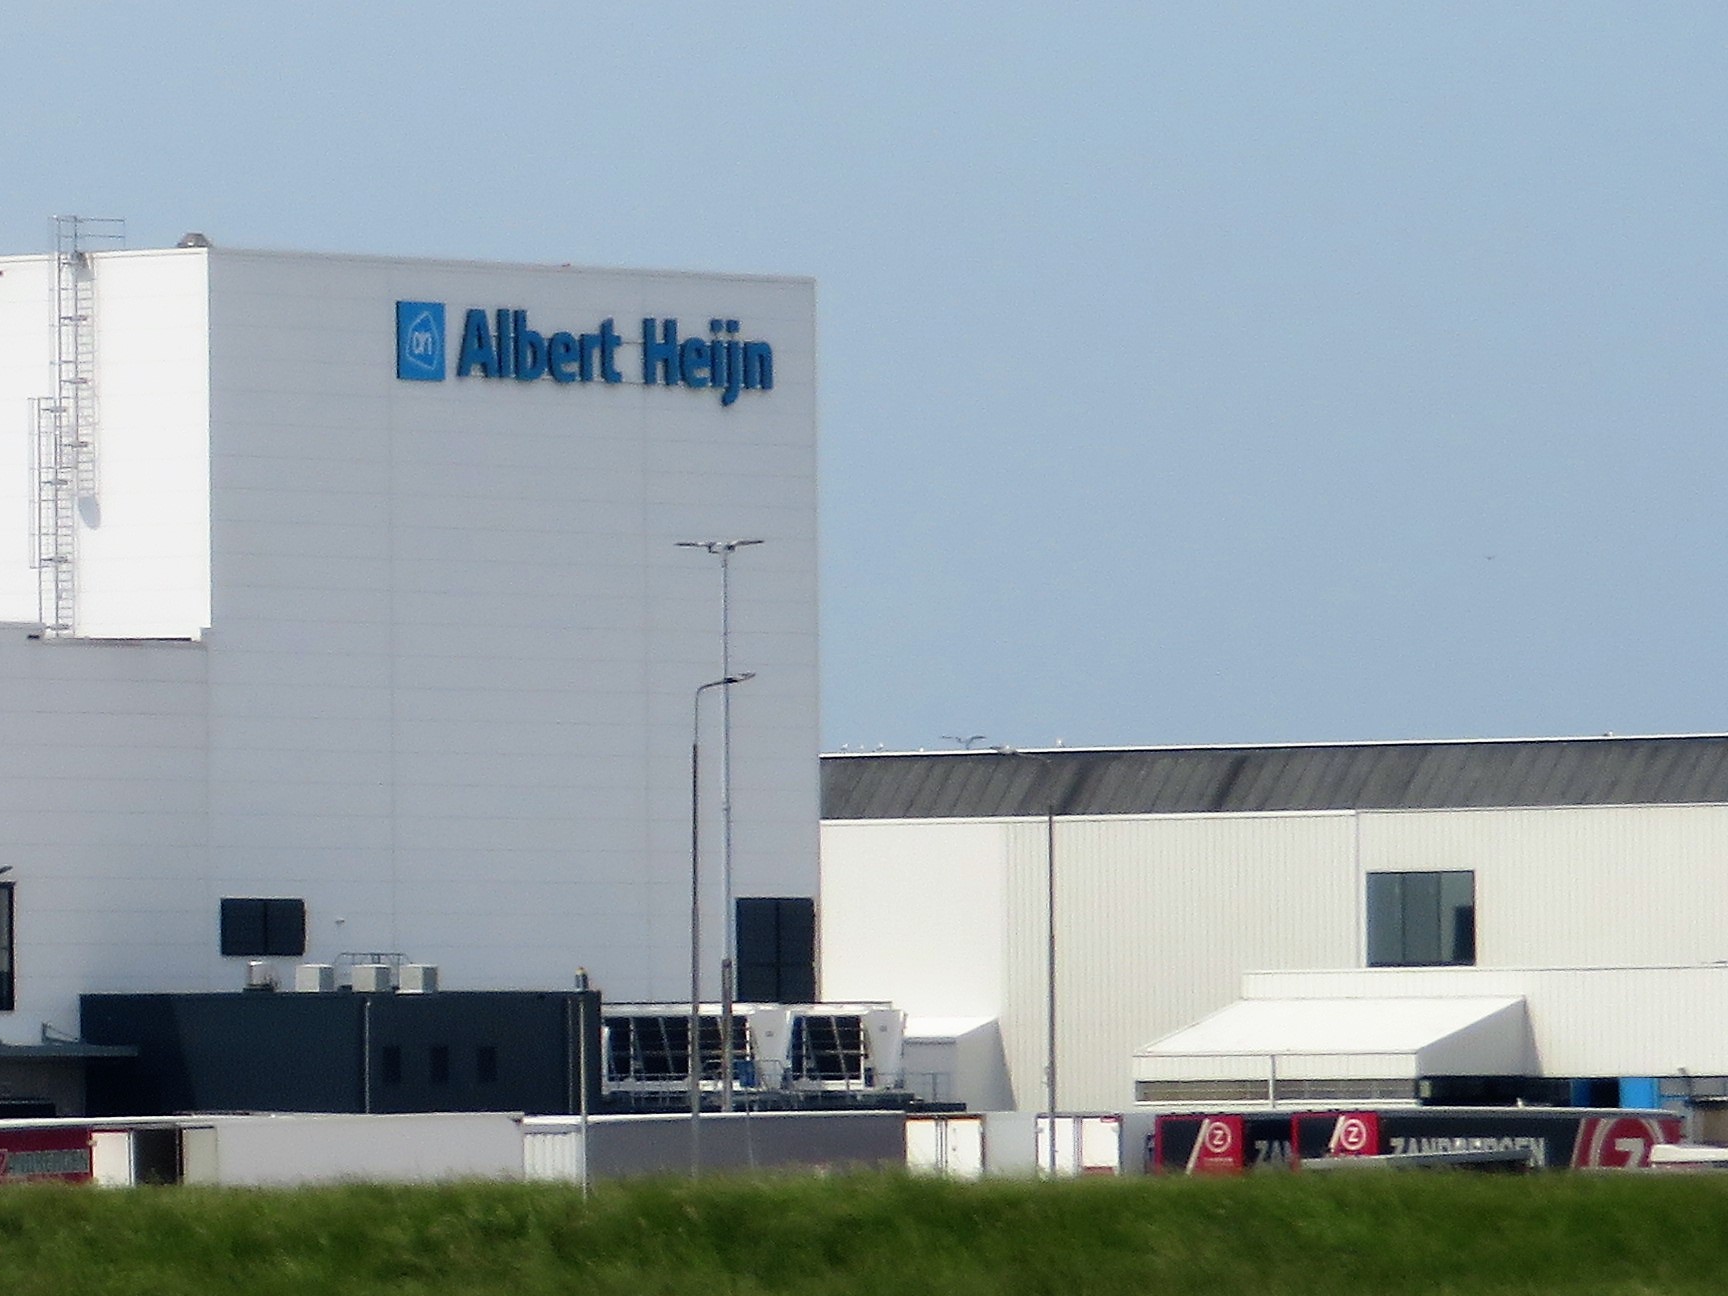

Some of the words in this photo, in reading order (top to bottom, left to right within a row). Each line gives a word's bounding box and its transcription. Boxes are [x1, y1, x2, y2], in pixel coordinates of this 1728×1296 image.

[457, 308, 622, 384] Albert
[643, 318, 774, 406] Heijn
[1213, 1130, 1224, 1145] Z
[1347, 1127, 1359, 1142] Z
